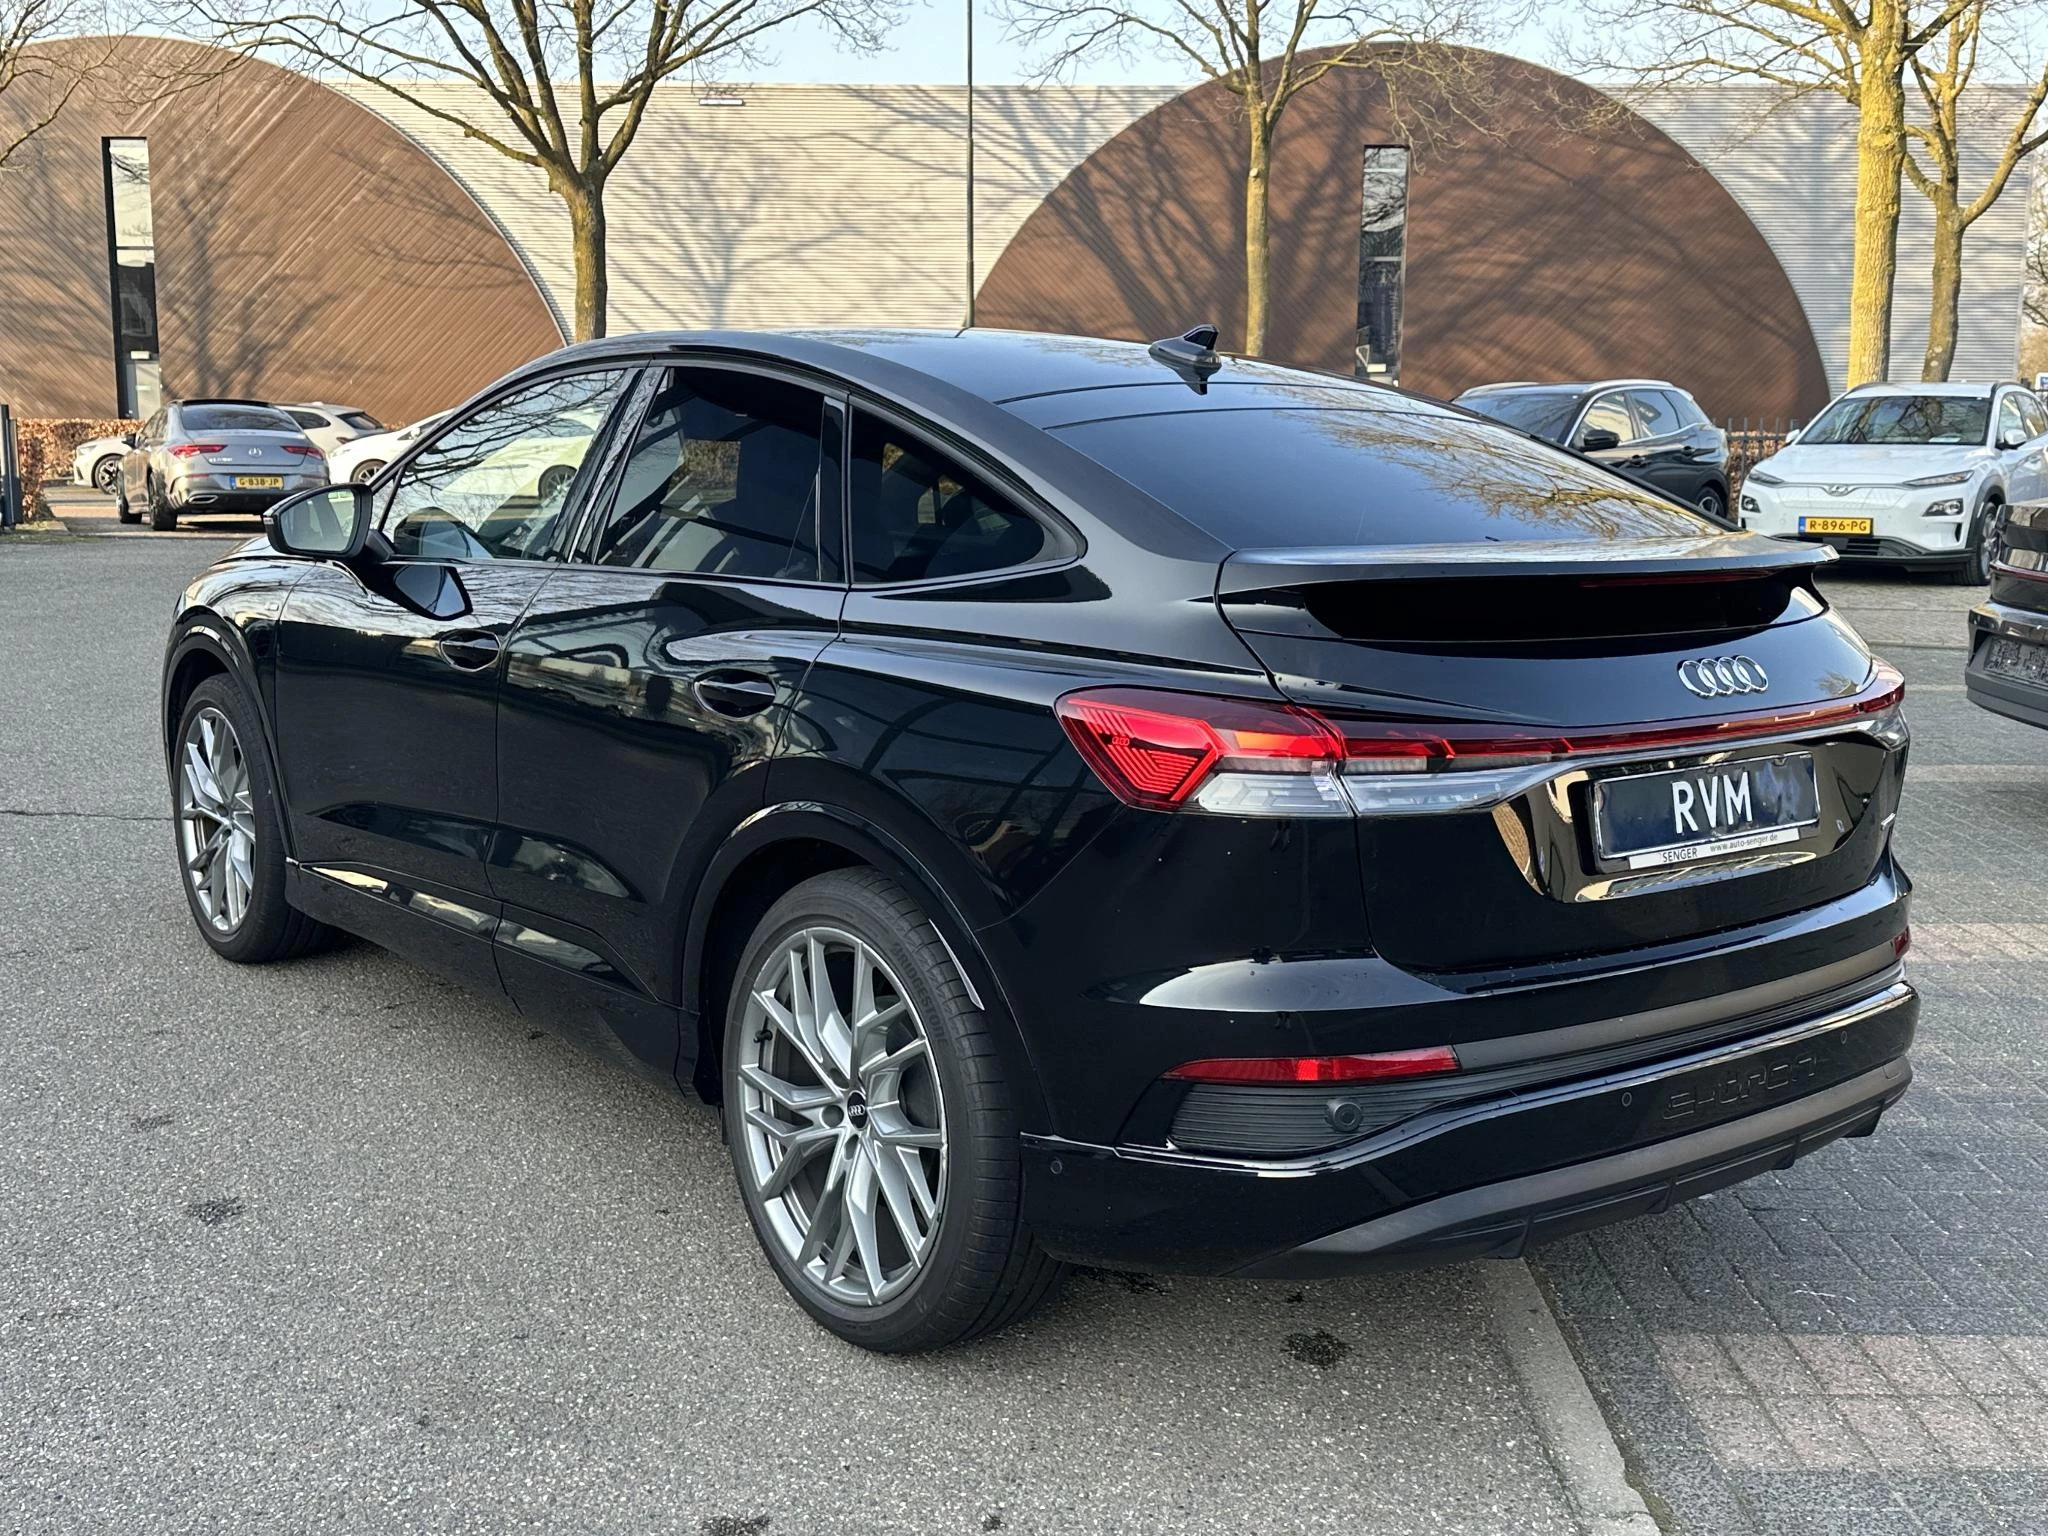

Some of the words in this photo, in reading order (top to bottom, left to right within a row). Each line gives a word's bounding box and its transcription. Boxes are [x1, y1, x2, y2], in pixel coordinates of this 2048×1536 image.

[239, 478, 279, 487] G-838-JP
[1809, 520, 1867, 532] R-896-PG
[1672, 771, 1753, 834] RVM
[1662, 847, 1698, 862] SENGER
[1710, 832, 1778, 853] www.auto-senger.de
[890, 940, 951, 1047] BRIDGESTONE
